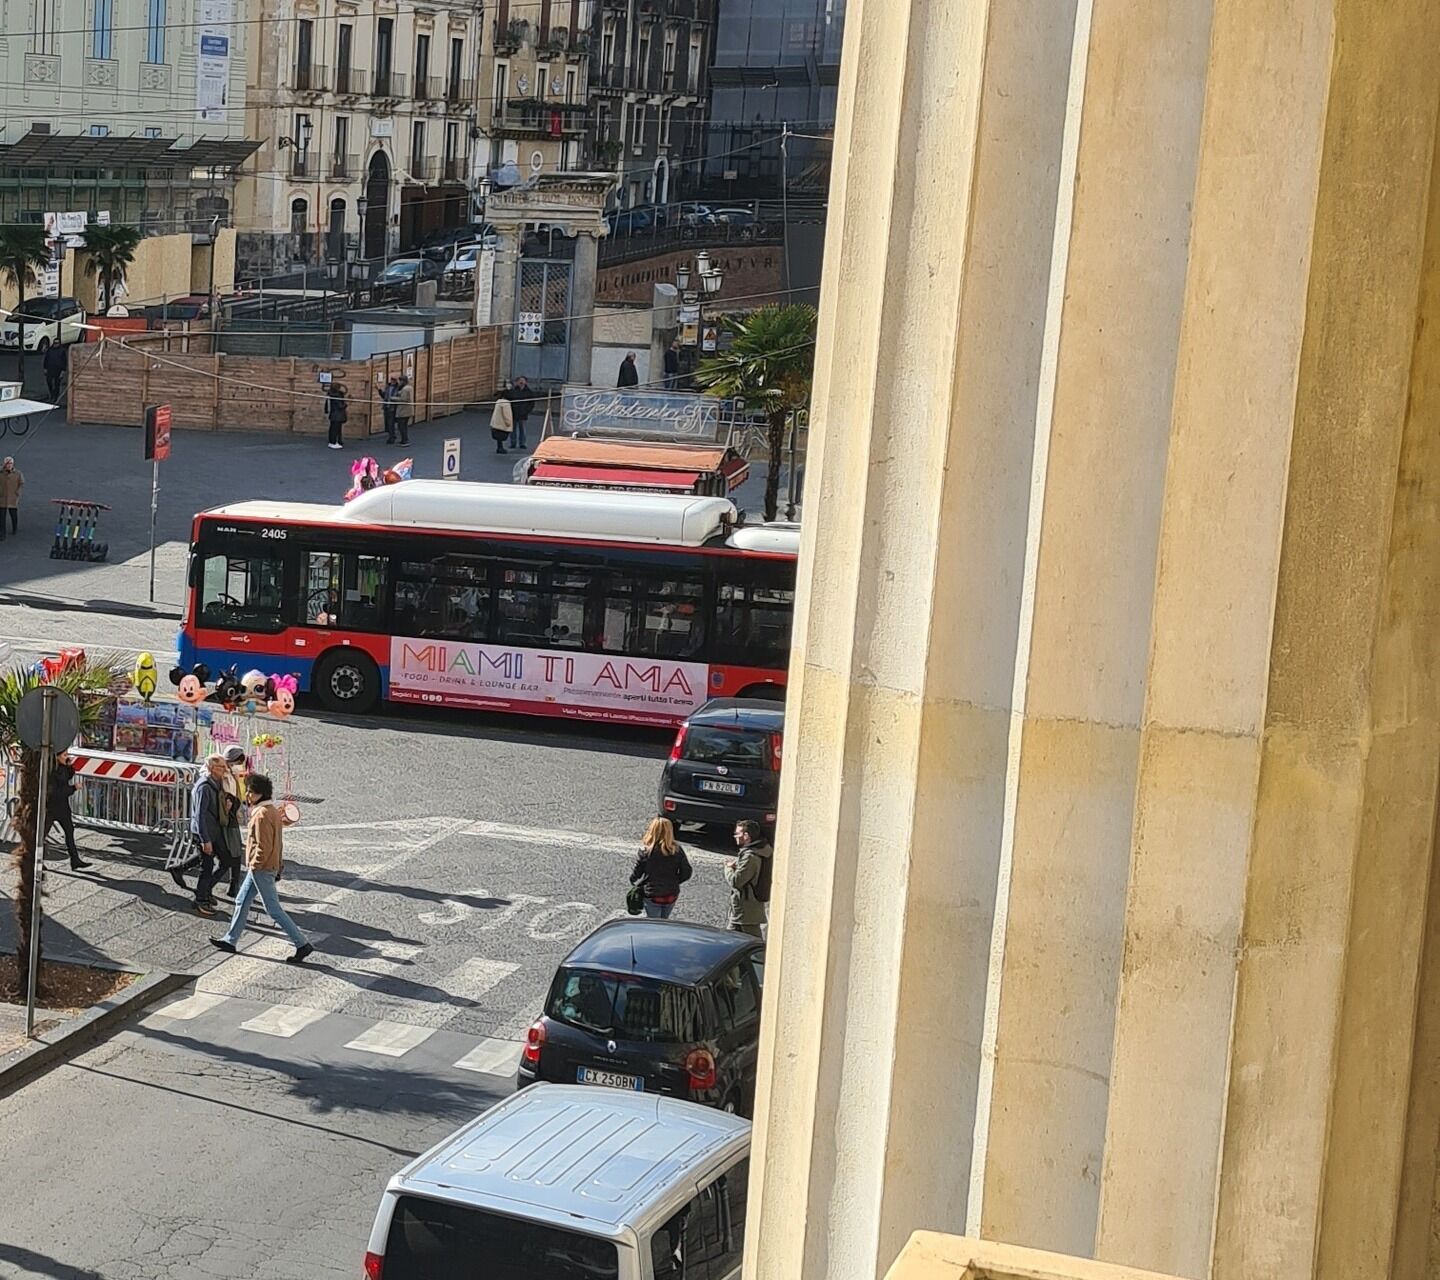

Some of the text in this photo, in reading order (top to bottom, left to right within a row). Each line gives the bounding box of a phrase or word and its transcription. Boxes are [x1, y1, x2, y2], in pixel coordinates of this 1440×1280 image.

[261, 528, 287, 540] 2405
[403, 643, 693, 696] MIAMI TI AMA
[479, 680, 517, 690] LOUNGE
[520, 683, 539, 692] BAR
[623, 694, 647, 703] aperti
[648, 695, 668, 704] tutto
[585, 1070, 635, 1089] CX 250BN
